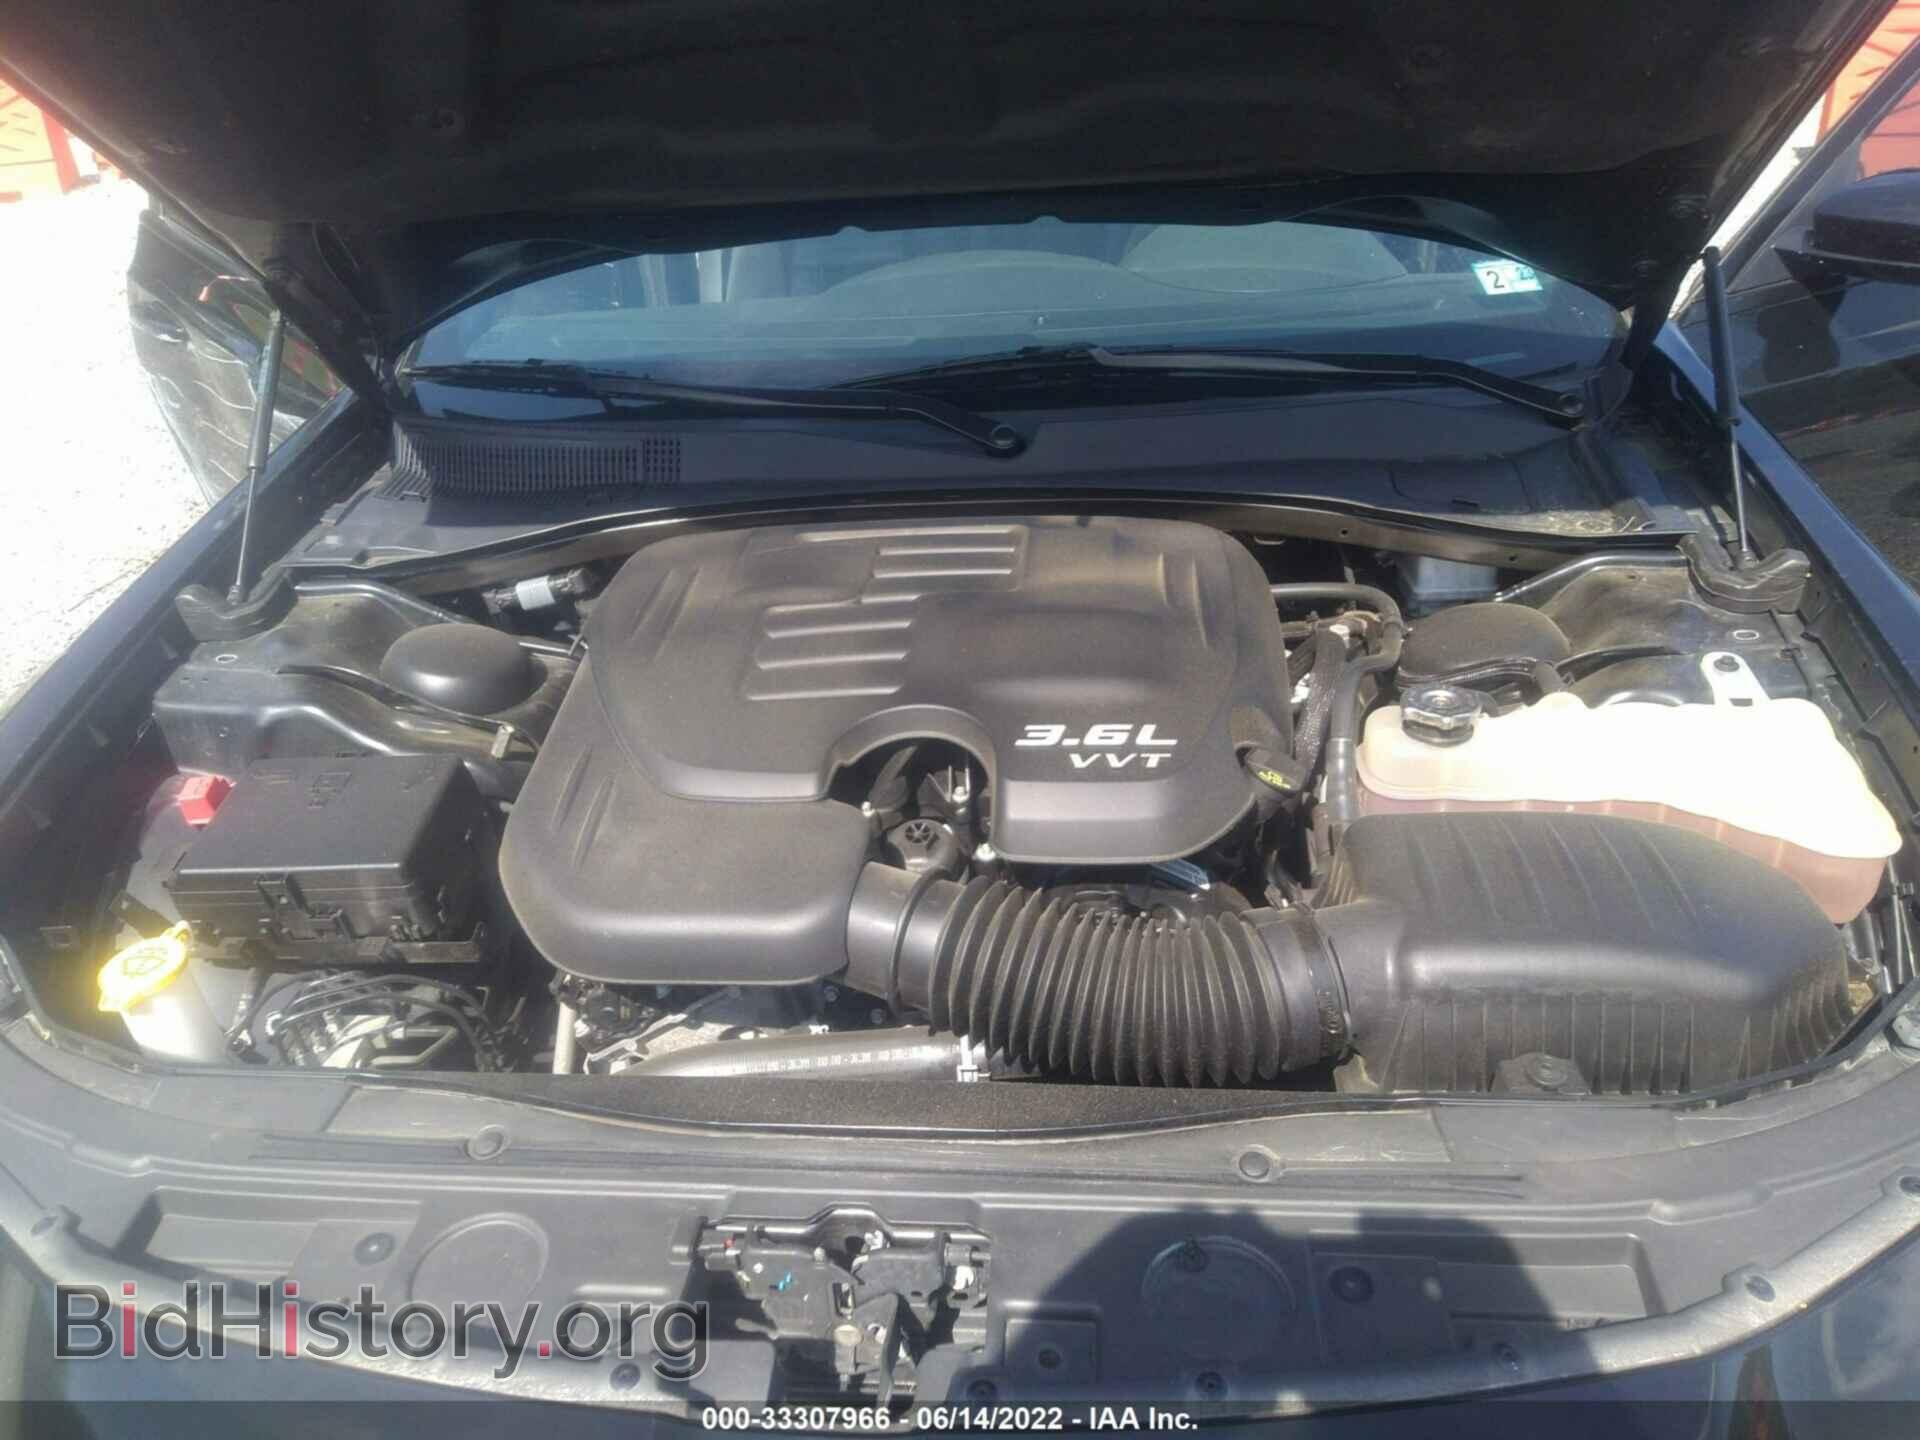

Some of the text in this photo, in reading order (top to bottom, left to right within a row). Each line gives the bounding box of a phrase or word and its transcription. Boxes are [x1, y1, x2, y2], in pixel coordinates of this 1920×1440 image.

[1486, 270, 1505, 288] 2
[1014, 723, 1178, 746] 3.6L
[1069, 753, 1172, 768] VVT
